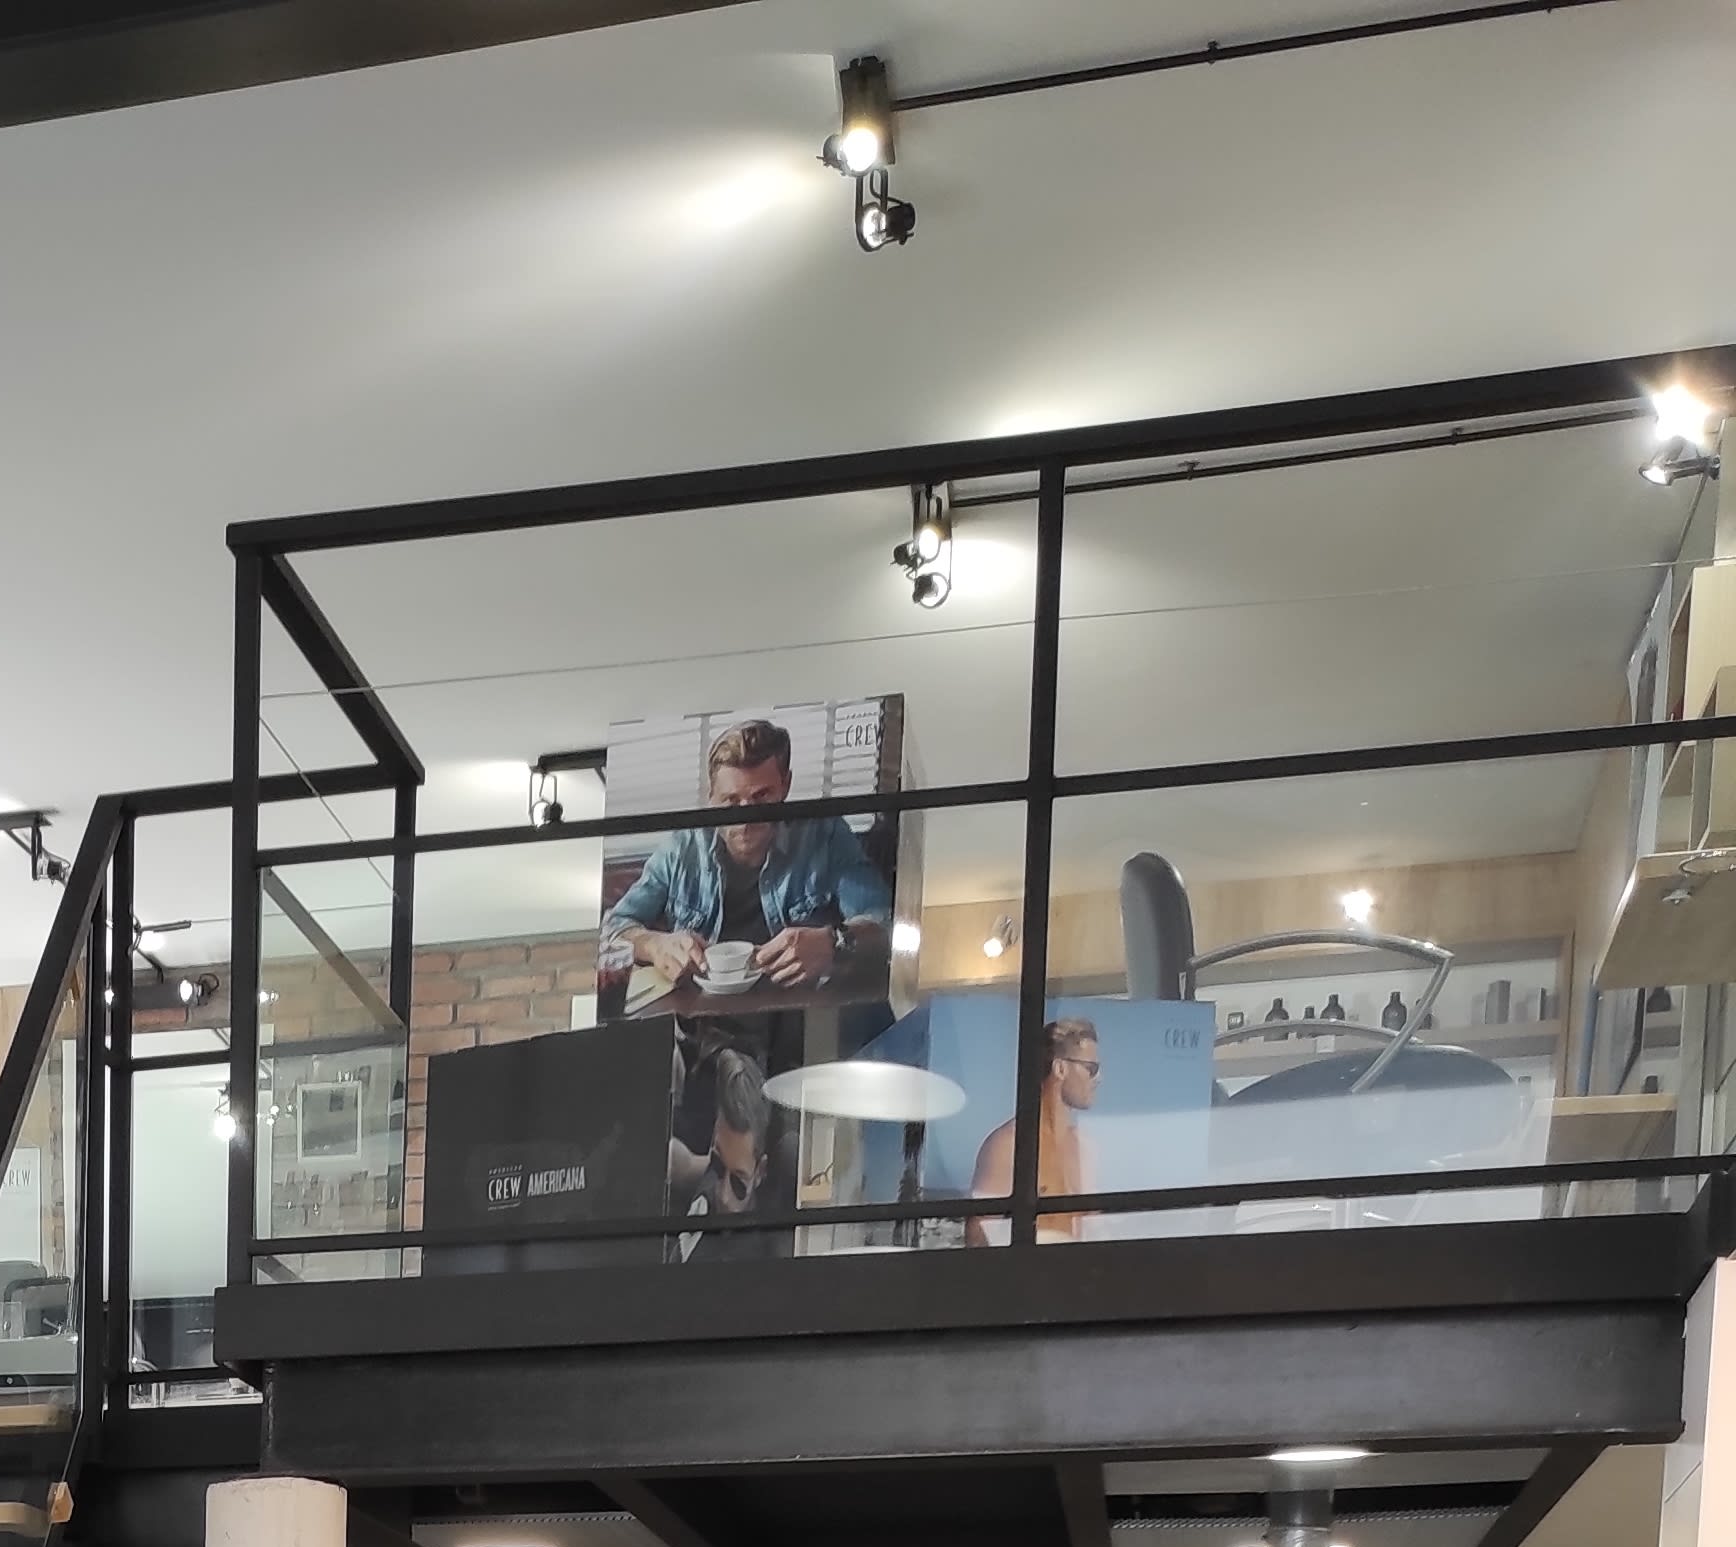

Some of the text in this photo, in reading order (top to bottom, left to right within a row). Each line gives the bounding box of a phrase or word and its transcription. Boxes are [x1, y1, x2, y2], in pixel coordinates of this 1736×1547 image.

[4, 1168, 31, 1187] REW
[488, 1165, 586, 1202] CREW AMERICANA
